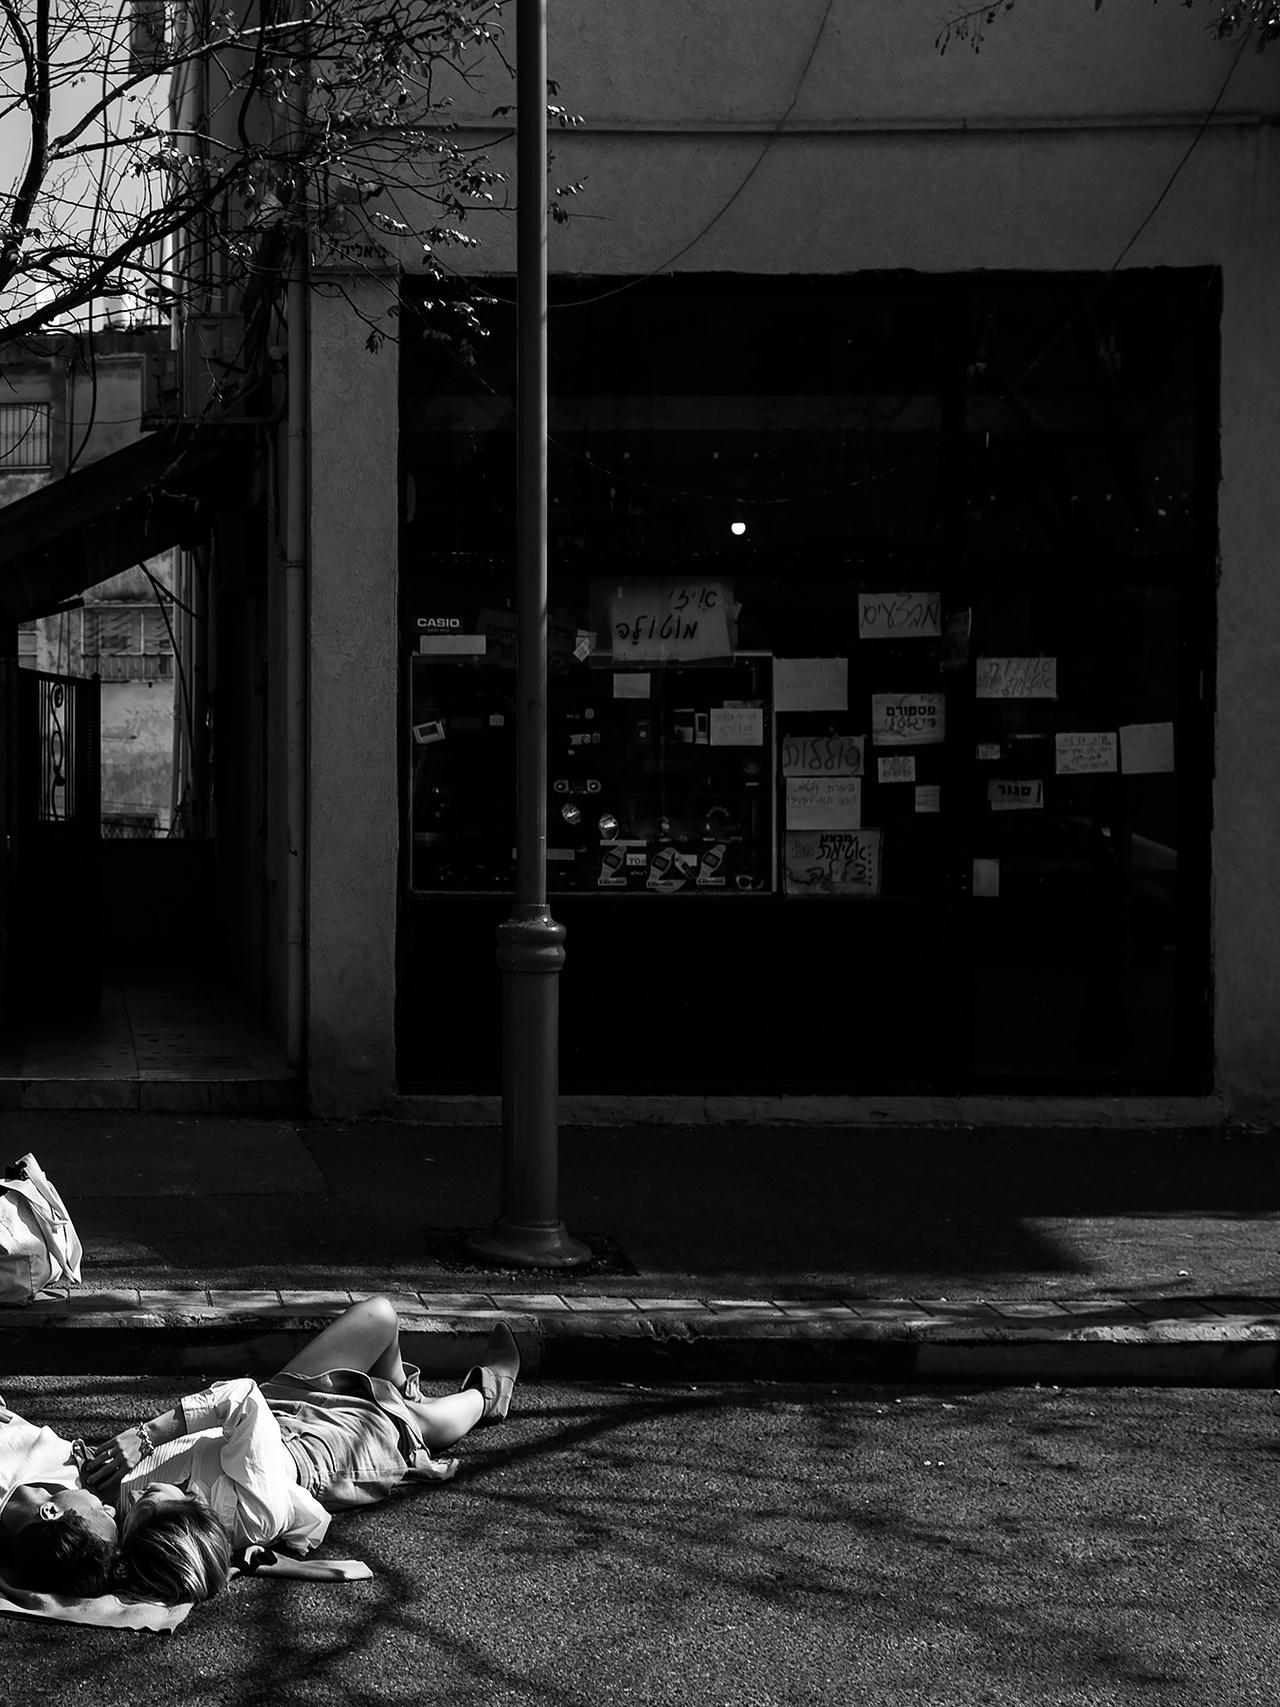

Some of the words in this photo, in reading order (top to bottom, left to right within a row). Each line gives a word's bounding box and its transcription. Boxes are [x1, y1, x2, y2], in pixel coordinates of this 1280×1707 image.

[860, 594, 940, 630] מבצעים
[416, 617, 461, 628] CASIO
[886, 706, 936, 716] פספורט
[998, 785, 1032, 796] סגור
[821, 834, 852, 843] מבצע
